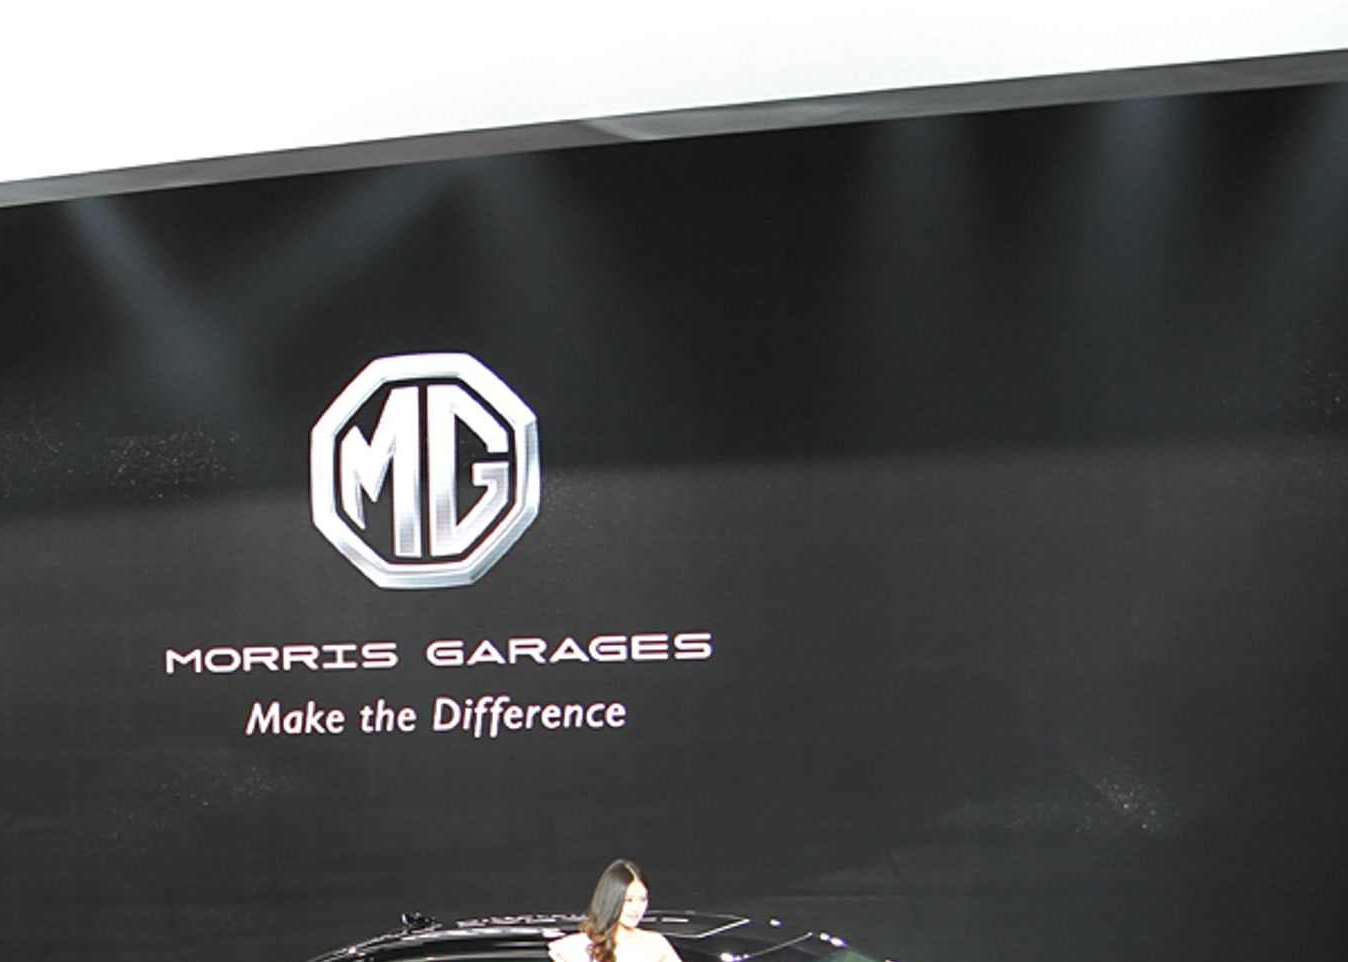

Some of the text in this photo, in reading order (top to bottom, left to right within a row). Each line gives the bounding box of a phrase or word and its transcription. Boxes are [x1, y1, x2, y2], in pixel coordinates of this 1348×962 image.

[340, 384, 509, 558] MG
[165, 632, 712, 674] MORRIS GARAGES
[245, 695, 626, 739] Make the Difference
